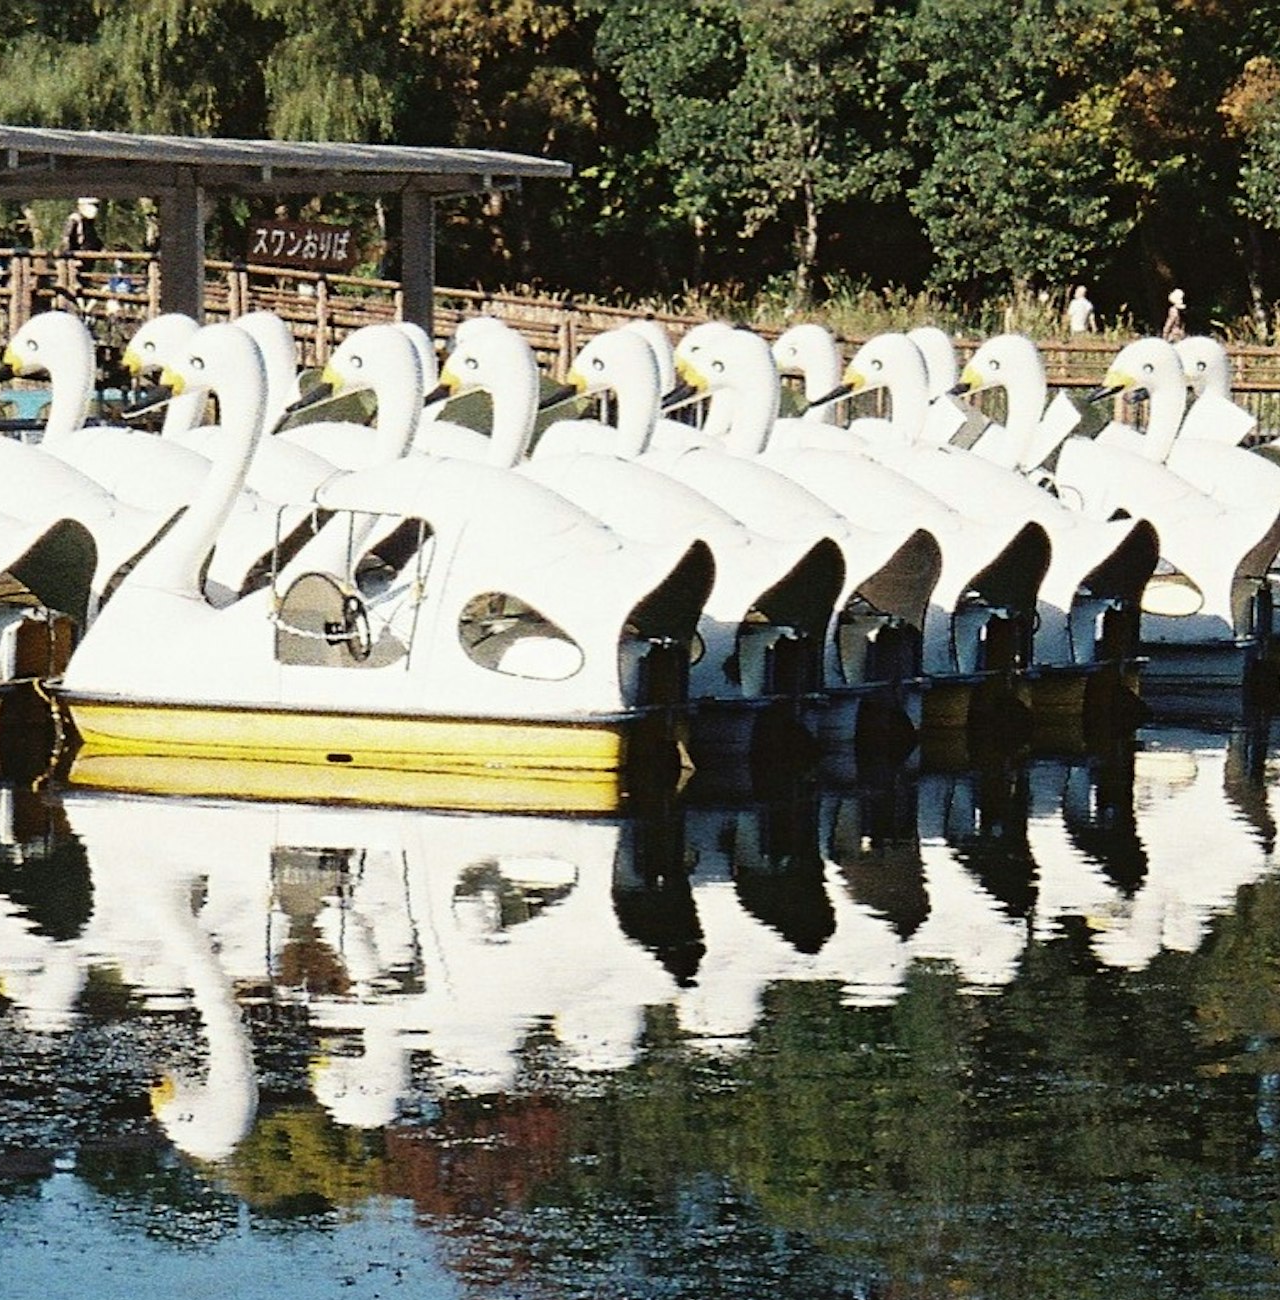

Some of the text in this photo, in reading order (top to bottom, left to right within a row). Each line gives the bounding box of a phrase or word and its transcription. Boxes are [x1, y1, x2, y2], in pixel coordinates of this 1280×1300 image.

[252, 227, 352, 261] スワンおりば
